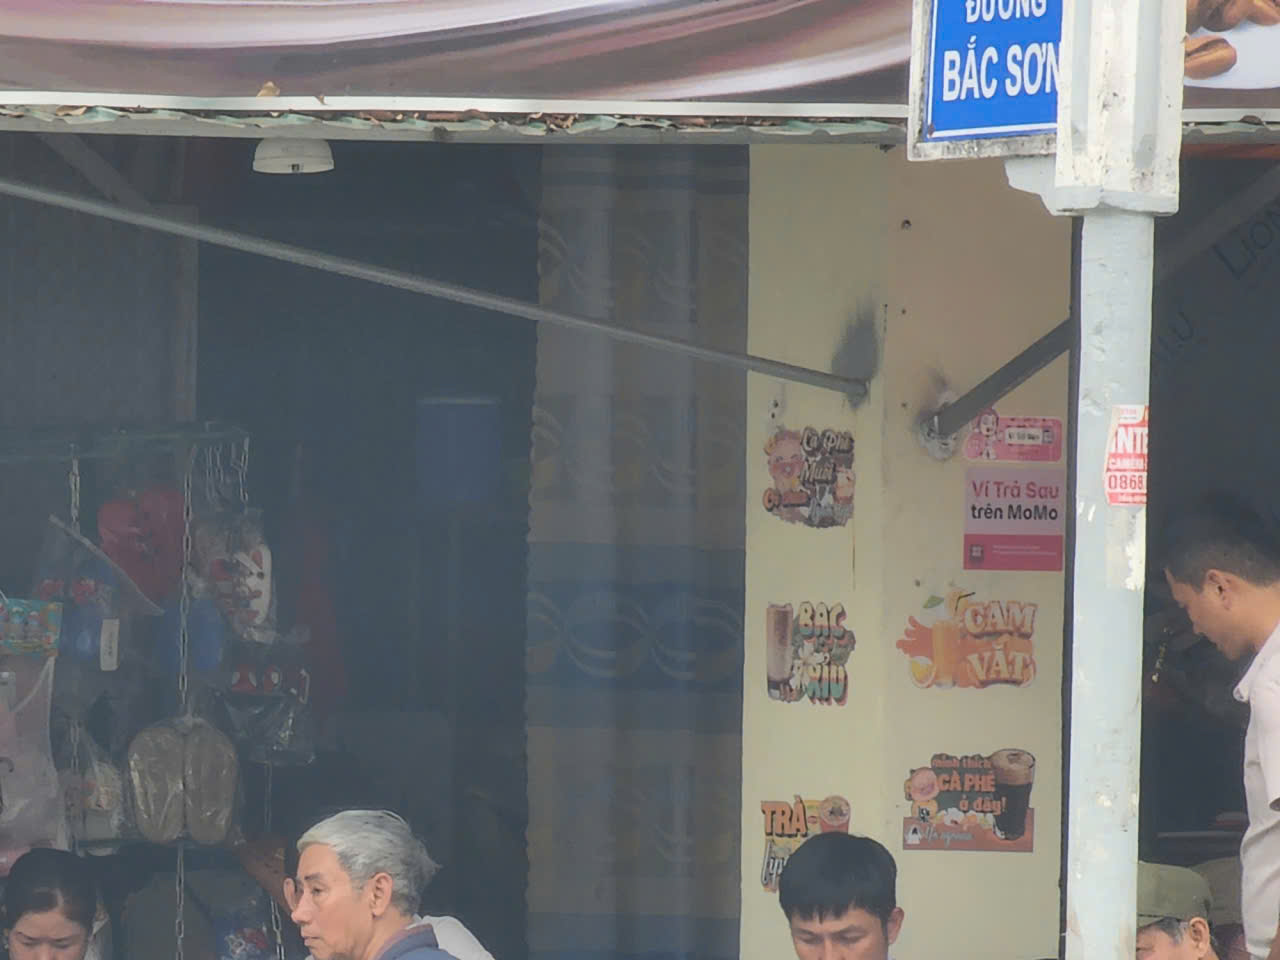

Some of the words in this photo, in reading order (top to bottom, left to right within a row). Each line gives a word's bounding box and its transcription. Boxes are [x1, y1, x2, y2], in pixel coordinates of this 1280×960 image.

[943, 35, 999, 101] BẮC
[1005, 42, 1060, 97] SƠN
[1026, 482, 1059, 499] Sau
[971, 503, 1003, 520] trên
[1007, 504, 1058, 520] MoMo
[964, 600, 1037, 640] CAM
[938, 768, 961, 792] CÀ
[761, 794, 807, 837] TRÀ
